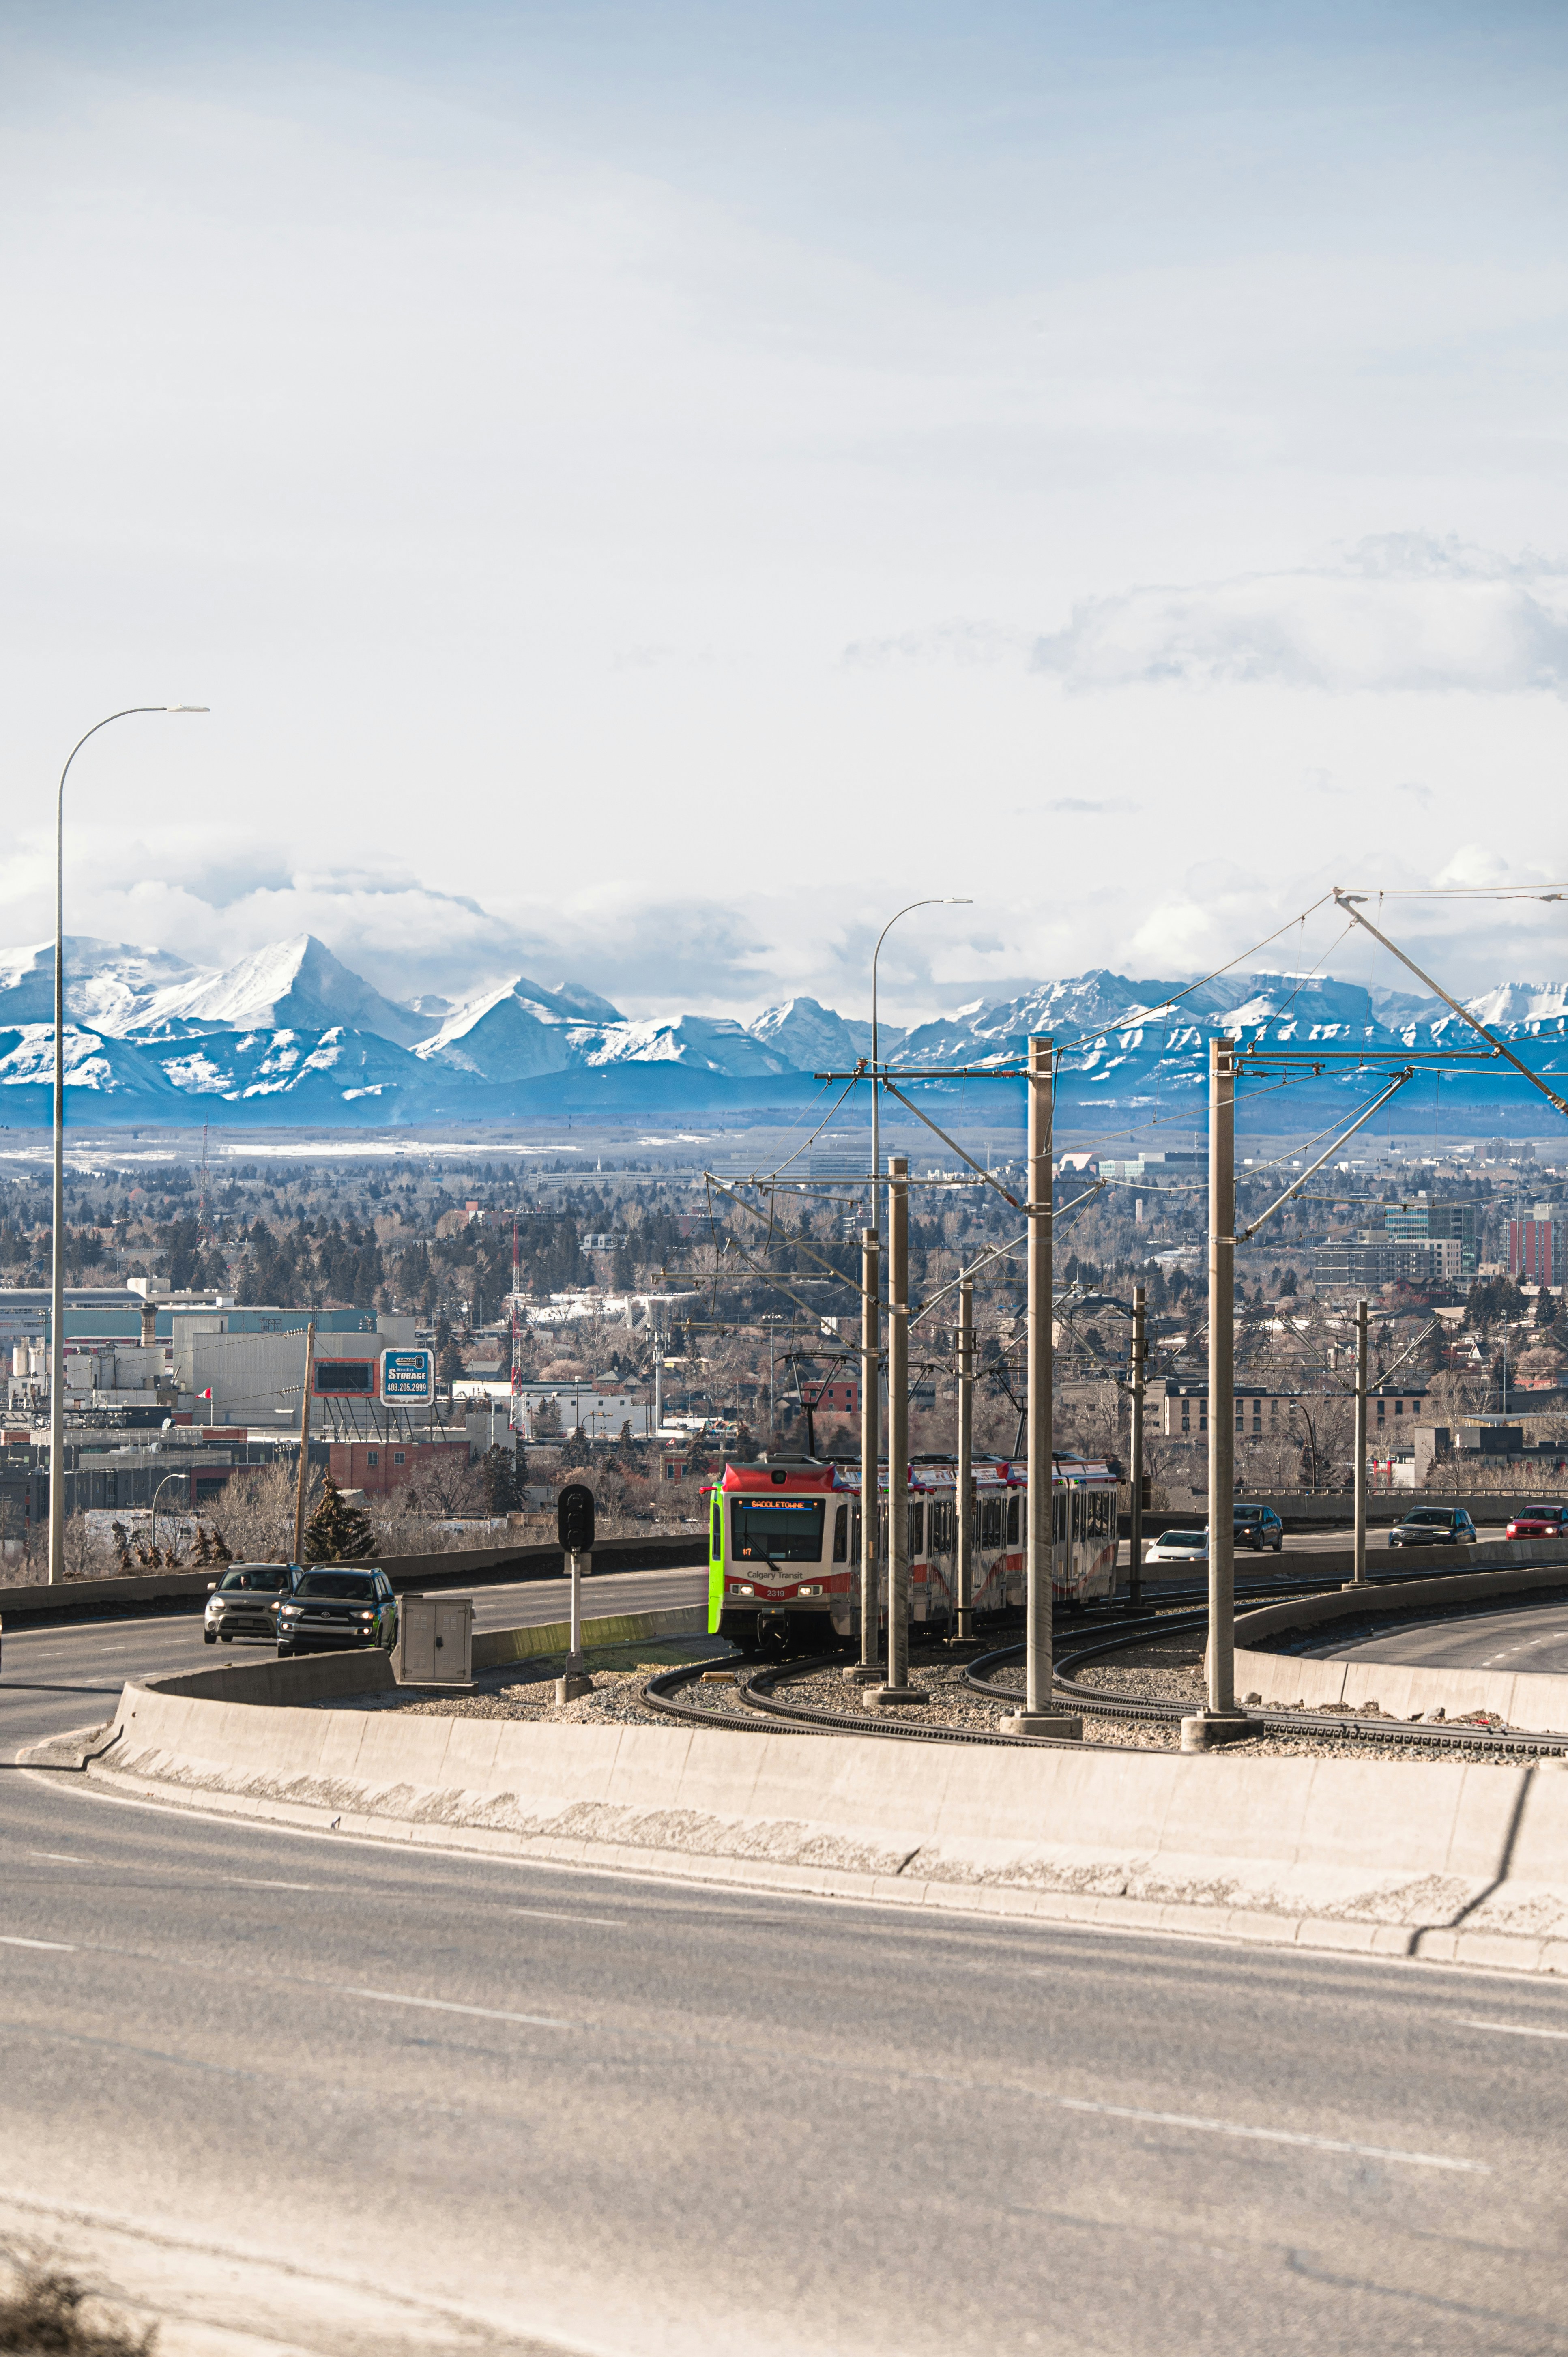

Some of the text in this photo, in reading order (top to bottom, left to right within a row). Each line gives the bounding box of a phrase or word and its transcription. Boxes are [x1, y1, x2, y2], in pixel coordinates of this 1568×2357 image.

[388, 1368, 426, 1379] STORAGE
[387, 1382, 426, 1392] 403.205.2999
[747, 1571, 775, 1580] Calgary
